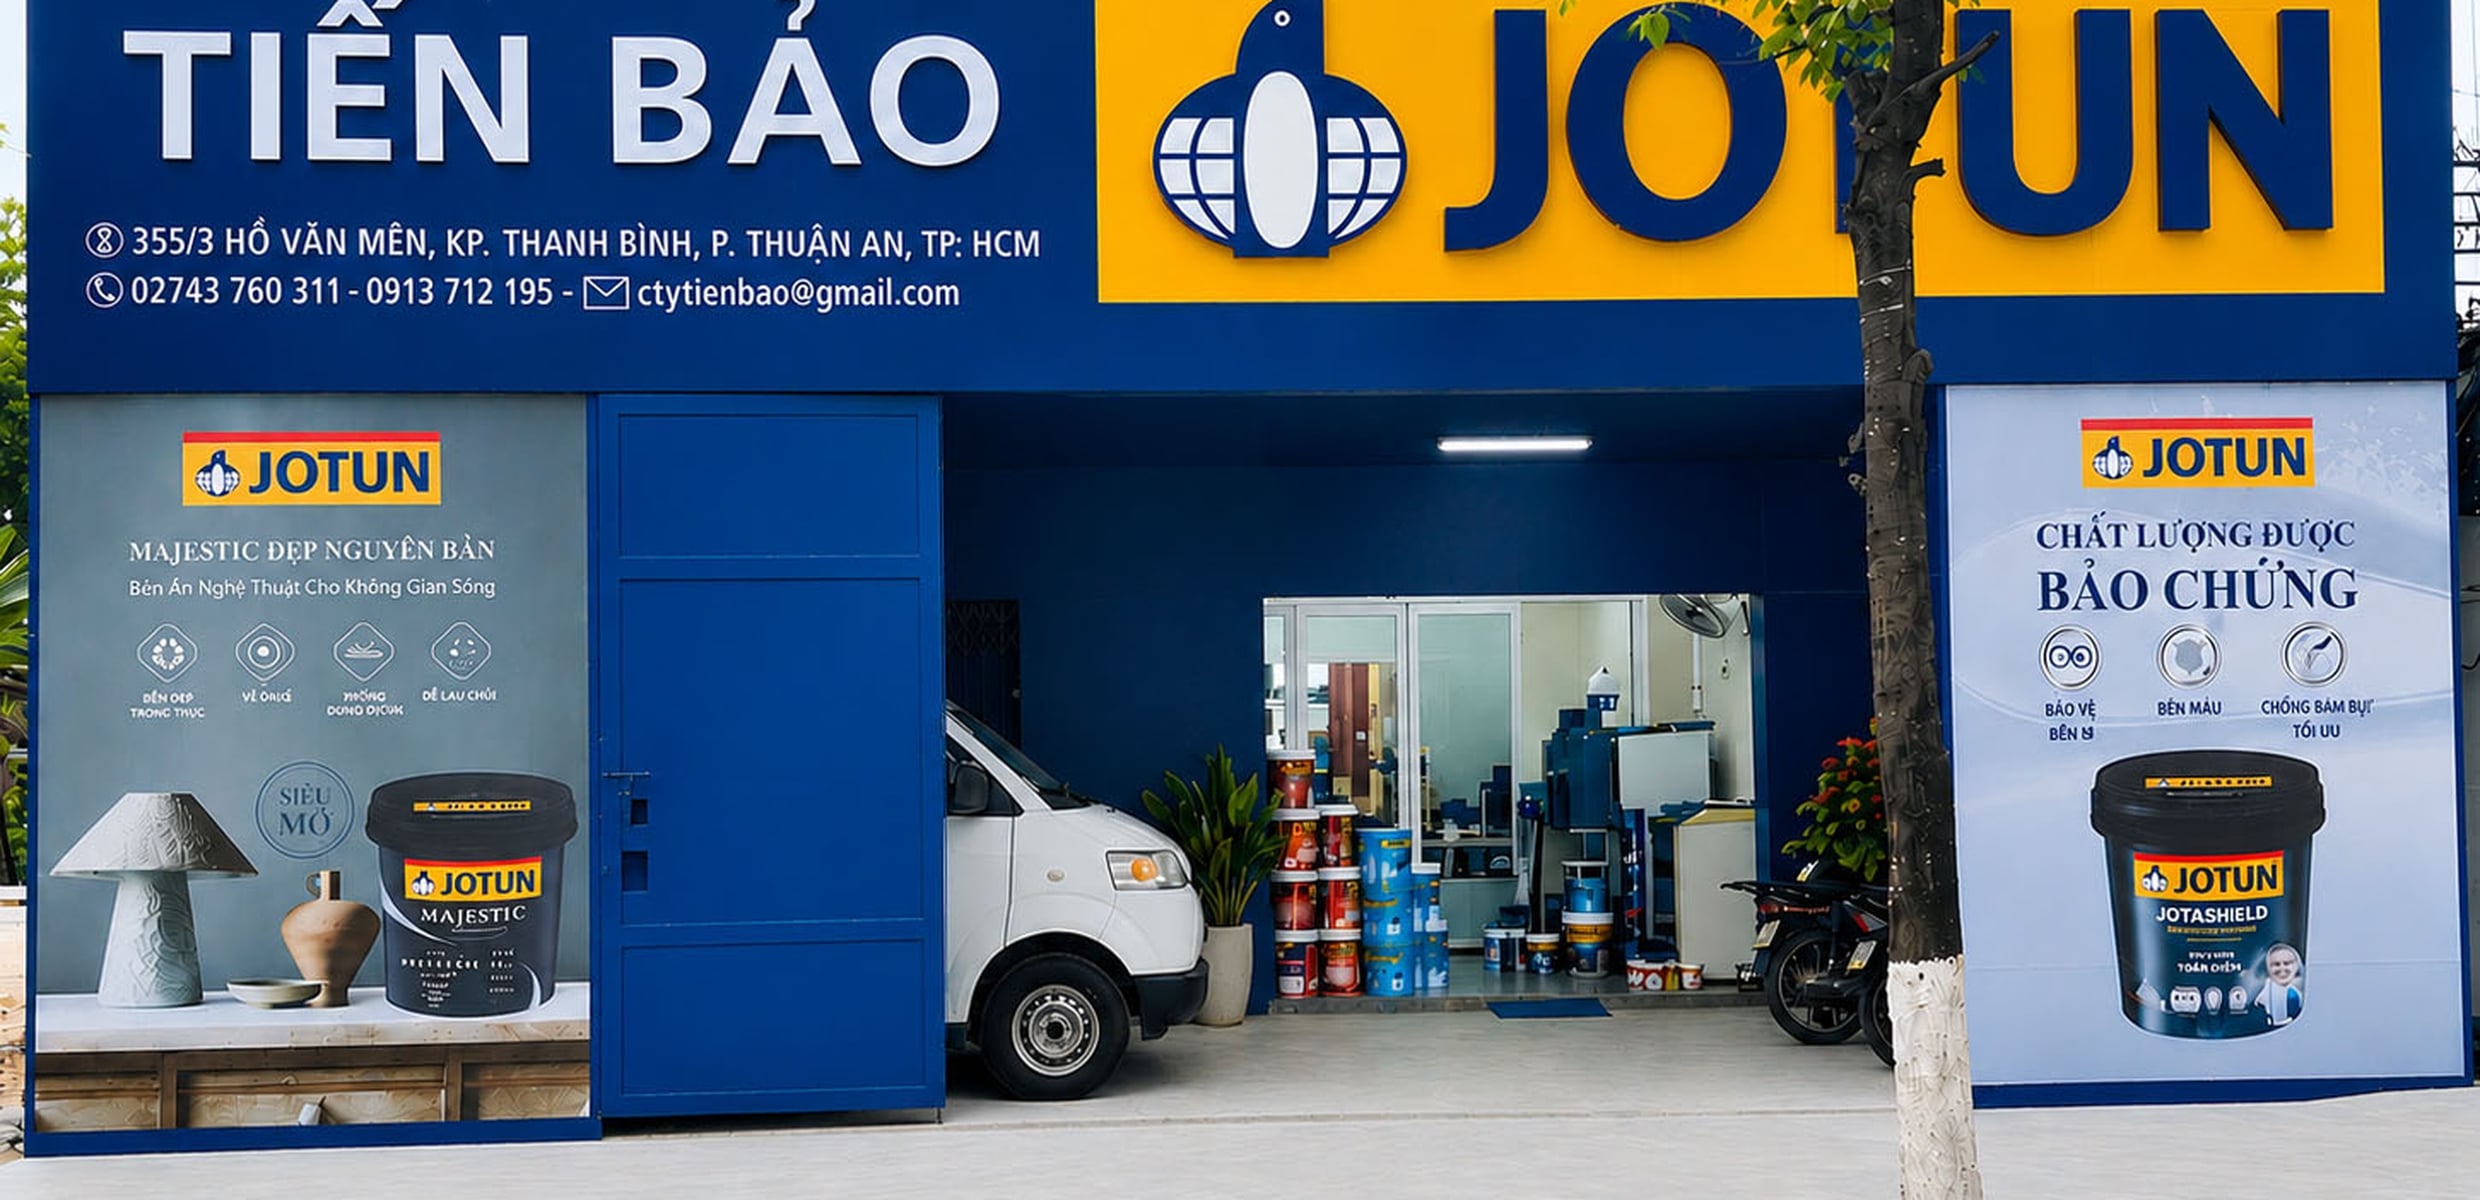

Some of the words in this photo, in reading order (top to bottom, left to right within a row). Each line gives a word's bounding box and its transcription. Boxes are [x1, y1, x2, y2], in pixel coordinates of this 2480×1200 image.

[123, 0, 529, 163] TIẾN
[611, 0, 1000, 167] BẢO
[1443, 2, 2334, 252] JOUN
[132, 226, 214, 255] 355/3
[226, 216, 270, 255] HỒ
[281, 221, 346, 255] VĂN
[358, 221, 435, 261] MÊN,
[447, 228, 489, 257] KP.
[502, 229, 608, 257] THANH
[620, 222, 700, 262] BÌNH,
[712, 229, 735, 257] P.
[746, 223, 850, 264] THUẬN
[860, 230, 912, 262] AN,
[921, 230, 962, 258] TP:
[973, 230, 1040, 257] HCM
[131, 276, 220, 304] 02743
[230, 276, 282, 304] 760
[292, 276, 338, 305] 311
[366, 276, 434, 305] 0913
[444, 277, 493, 305] 712
[505, 277, 553, 305] 195
[637, 276, 959, 314] ctytienbao@gmail.com
[249, 451, 430, 494] JOTUN
[2143, 437, 2306, 478] JOTUN
[129, 540, 261, 566] MAJESTIC
[267, 540, 318, 566] ĐẸP
[324, 535, 435, 562] NGUYÊN
[2036, 511, 2129, 549] CHẤT
[2136, 517, 2252, 553] LƯỢNG
[2262, 517, 2355, 553] ĐƯỢC
[304, 577, 341, 597] Cho
[407, 577, 449, 597] Gian
[2037, 557, 2149, 612] BẢO
[2164, 556, 2358, 611] CHỨNG
[441, 870, 534, 895] JOTUN
[2174, 865, 2277, 894] JOTUN
[421, 906, 526, 928] MAJESTIC
[2156, 905, 2268, 924] JOTASHIELD
